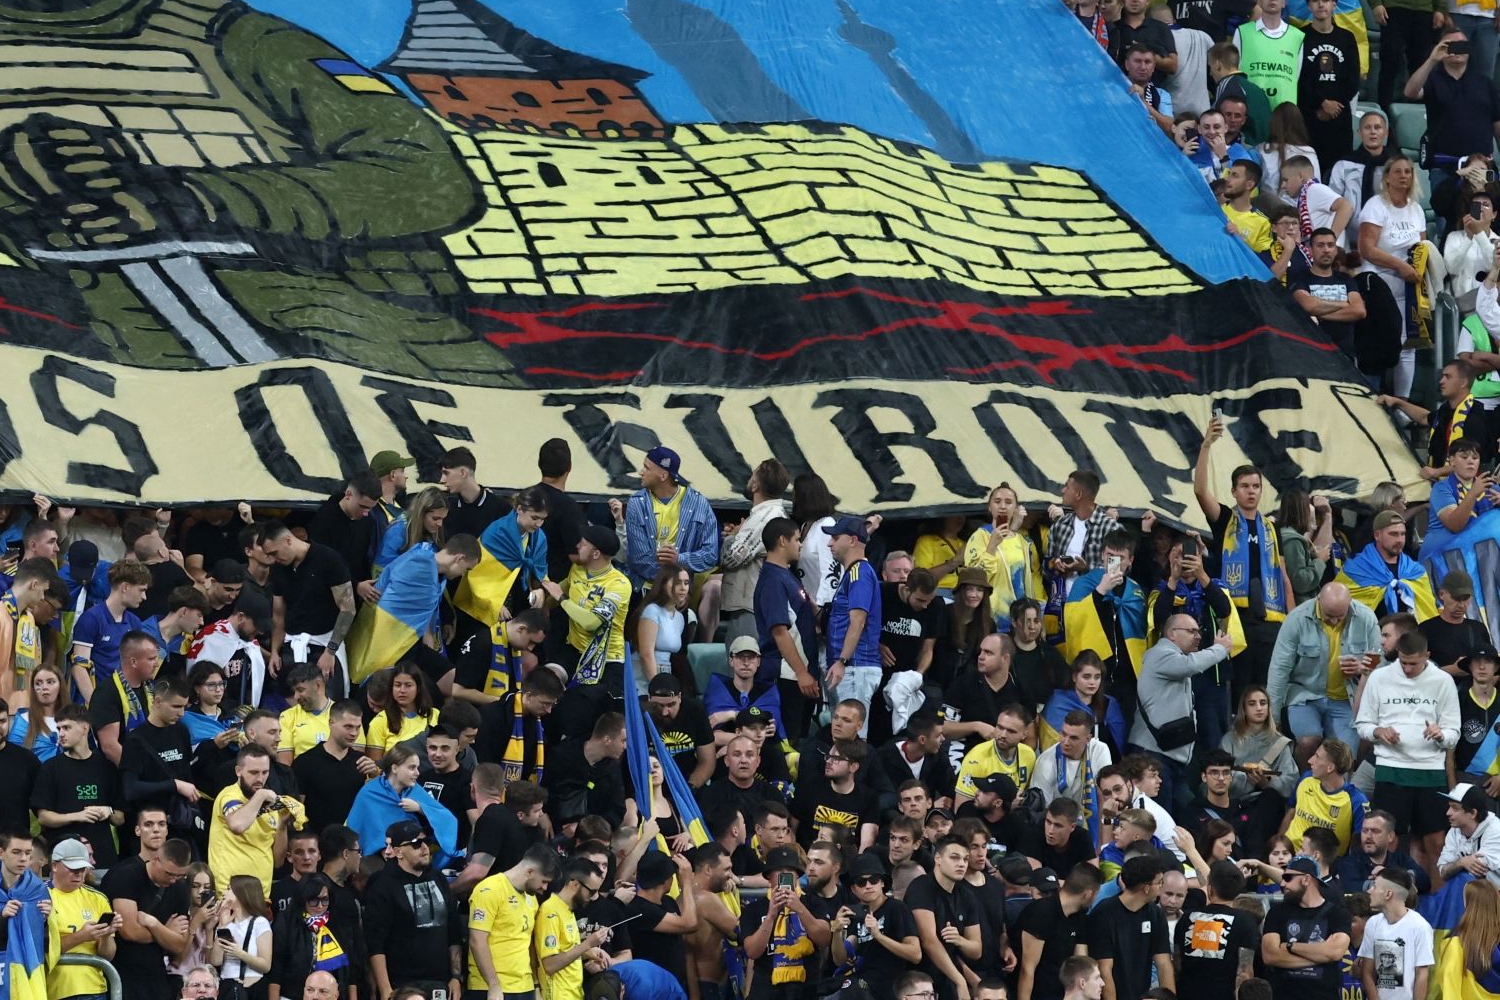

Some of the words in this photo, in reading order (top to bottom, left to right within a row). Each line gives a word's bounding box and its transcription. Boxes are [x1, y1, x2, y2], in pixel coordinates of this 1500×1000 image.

[1249, 62, 1293, 76] STEWARD
[1318, 73, 1336, 82] APE
[235, 367, 476, 496] OF
[543, 386, 1361, 518] EUROPE
[886, 620, 913, 632] NORTH
[899, 616, 913, 626] THE
[882, 626, 913, 637] ALTIVKA
[1382, 696, 1440, 706] JORDAN
[76, 784, 98, 796] 5:20
[1296, 807, 1337, 831] UKRAINE
